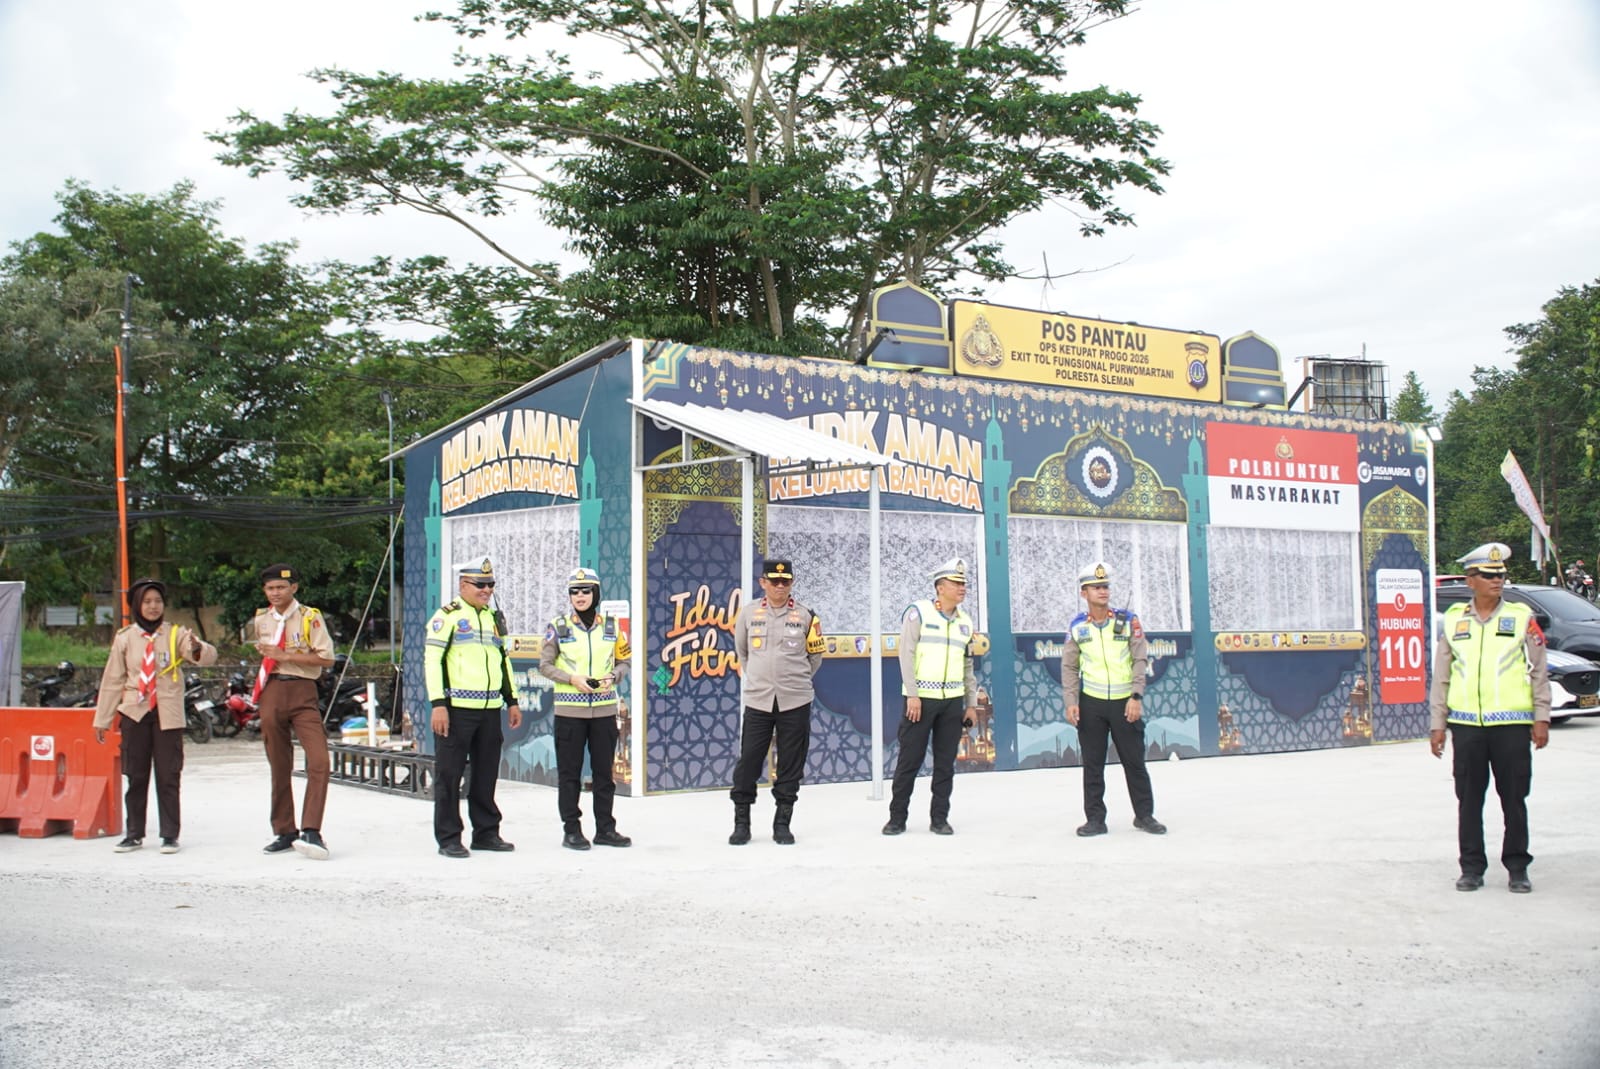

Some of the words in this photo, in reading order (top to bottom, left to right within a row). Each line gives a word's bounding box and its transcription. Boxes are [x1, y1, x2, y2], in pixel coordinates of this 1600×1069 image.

[1042, 319, 1076, 343] POS
[1081, 325, 1146, 352] PANTAU
[1011, 350, 1031, 362] EXIT
[1034, 353, 1051, 365] TOL
[1053, 356, 1108, 372] FUNGSIONAL
[1109, 363, 1174, 379] PURWOMARTANI
[1039, 341, 1057, 353] OPS
[1059, 344, 1097, 358] KETUPAT
[1099, 349, 1128, 362] PROGO
[1129, 353, 1150, 365] 2026
[1055, 368, 1099, 384] POLRESTA
[1101, 374, 1135, 387] SLEMAN
[442, 411, 508, 484] MUDIK
[508, 409, 579, 466] AMAN
[769, 411, 880, 468] DIK
[884, 413, 983, 482] AMAN
[442, 460, 512, 514] KELUARGA
[511, 458, 579, 499] BAHAGIA
[1229, 458, 1280, 477] POLRI
[1285, 463, 1340, 481] UNTUK
[888, 464, 983, 512] BAHAGIA
[1231, 484, 1340, 505] MASYARAKAT
[1380, 617, 1422, 630] HUBUNGI
[661, 628, 742, 688] Fitr
[1381, 635, 1422, 669] 110
